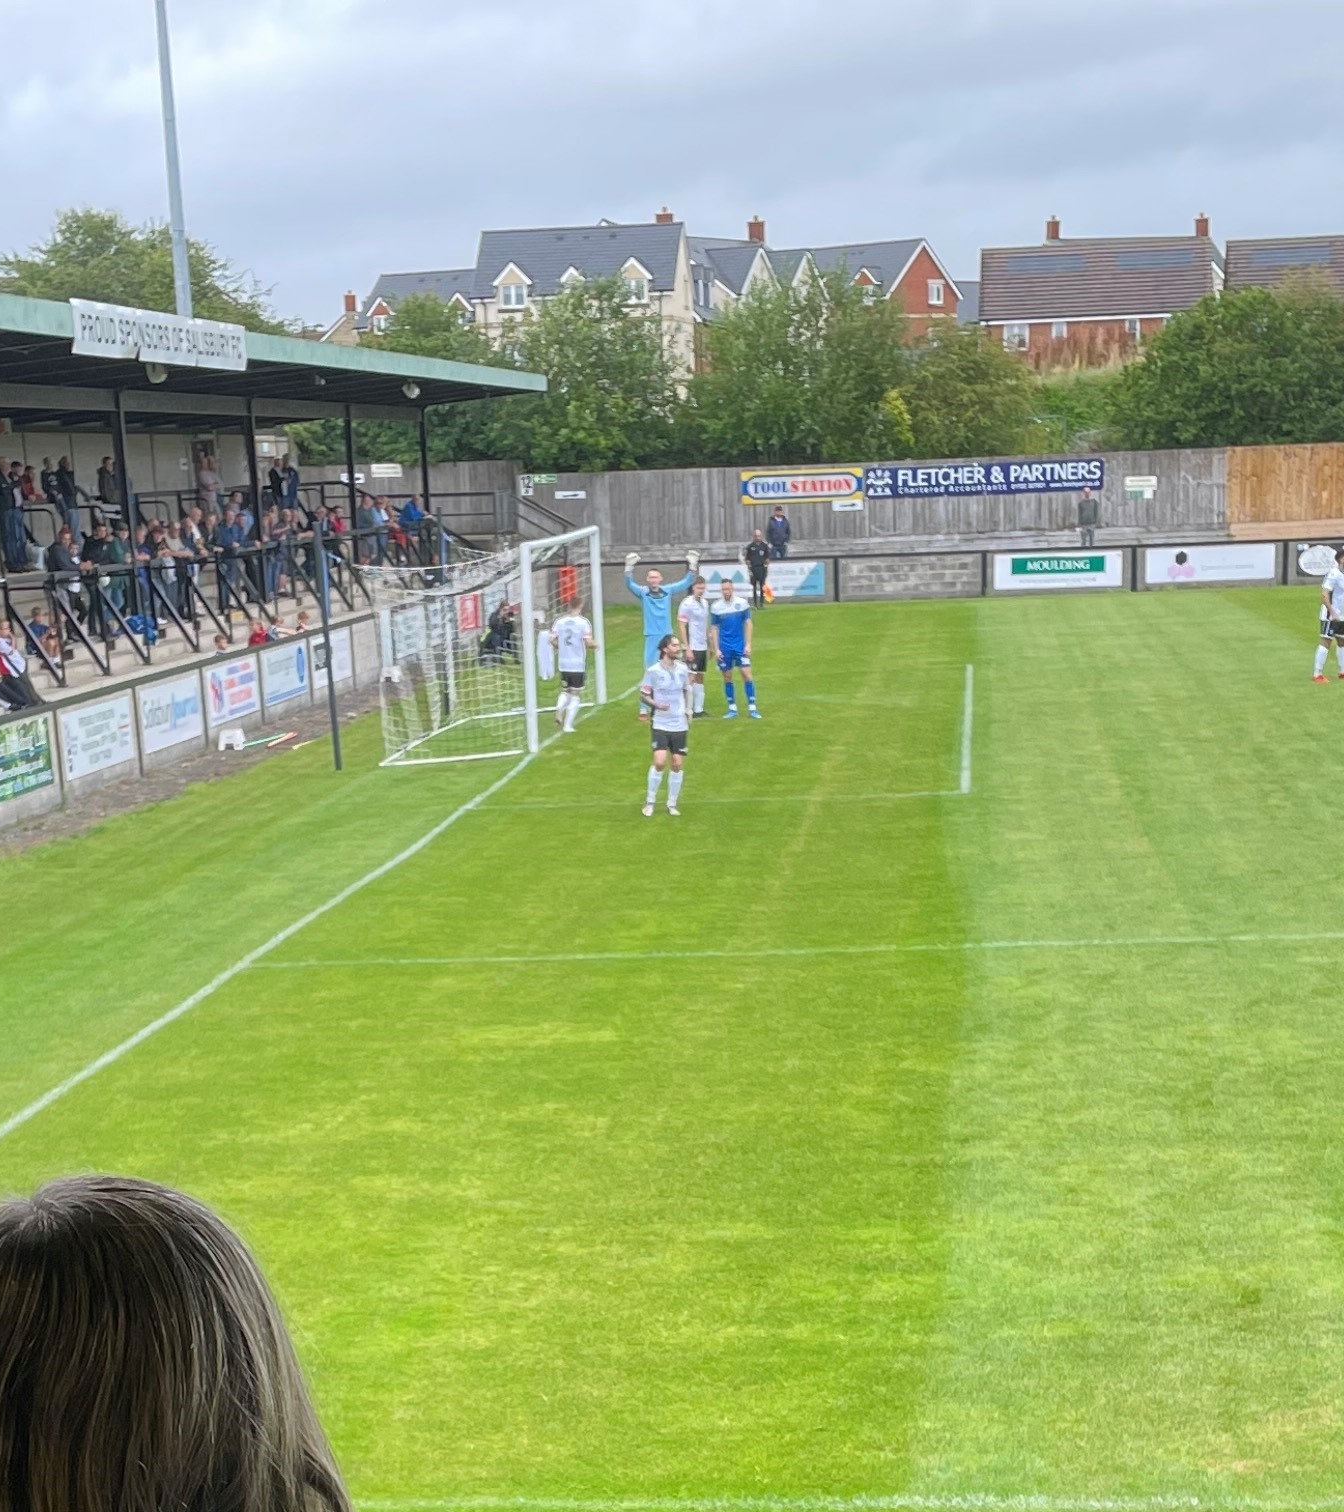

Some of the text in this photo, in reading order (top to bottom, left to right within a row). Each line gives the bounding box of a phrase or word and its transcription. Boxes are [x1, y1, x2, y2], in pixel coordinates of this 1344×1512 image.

[81, 312, 117, 345] PROUD
[118, 318, 171, 352] SPONSORS
[897, 461, 1101, 487] FLETCHER & PARTNERS
[752, 478, 852, 494] TOOLSTATION
[897, 484, 945, 495] Chartered
[948, 482, 1007, 493] Accountants
[1026, 560, 1091, 571] MOULDING
[565, 629, 573, 646] 2
